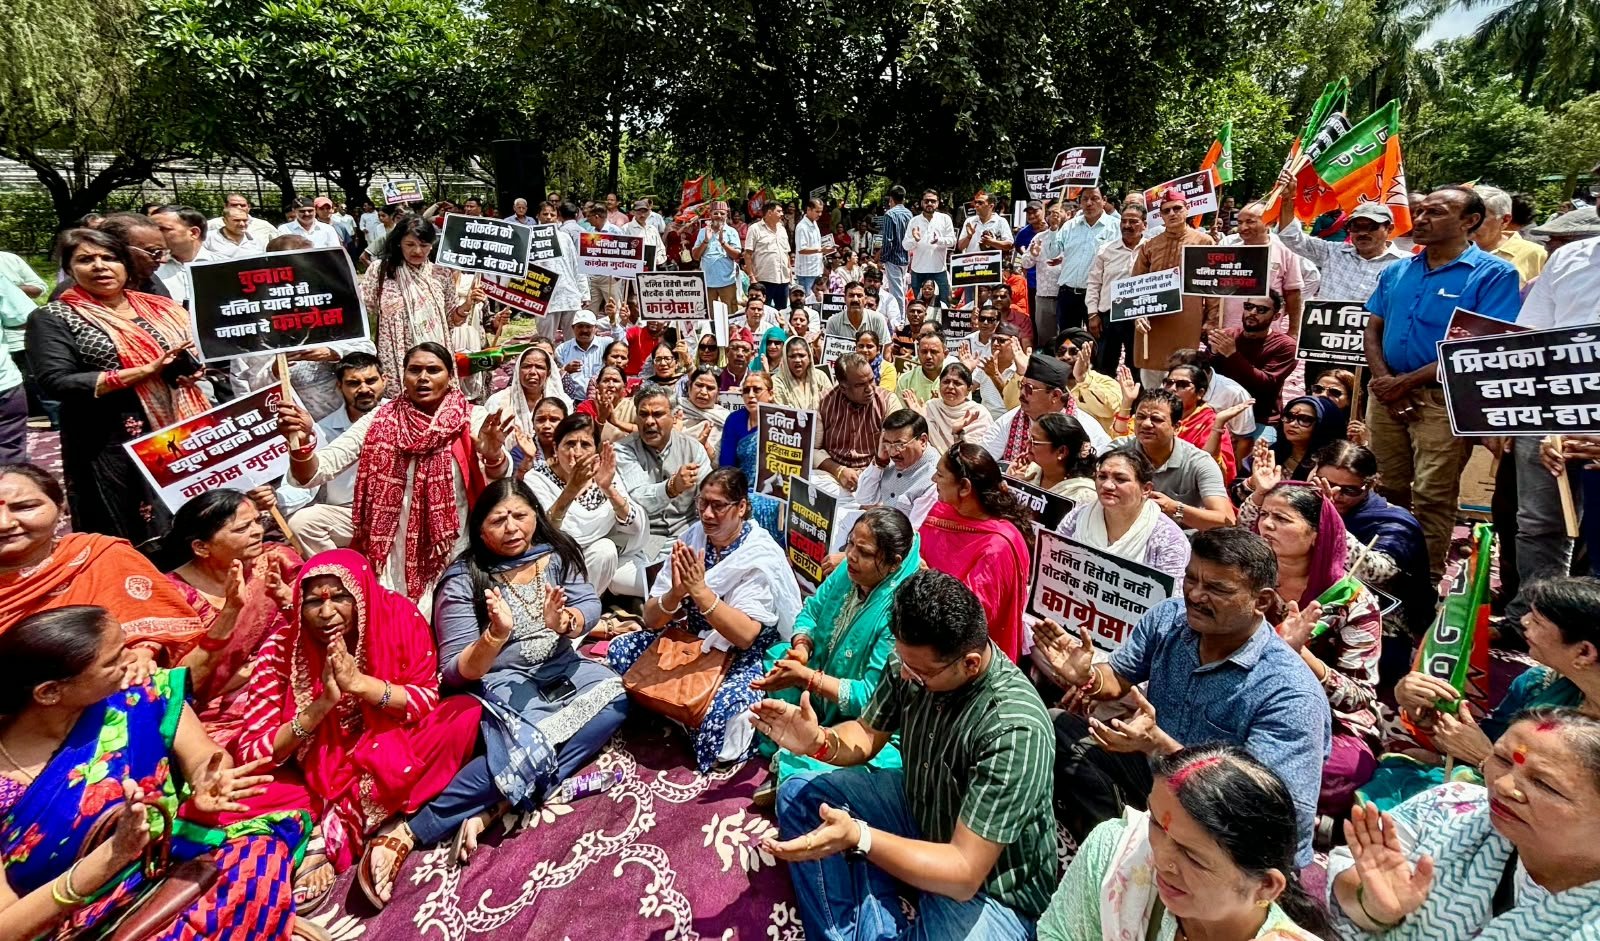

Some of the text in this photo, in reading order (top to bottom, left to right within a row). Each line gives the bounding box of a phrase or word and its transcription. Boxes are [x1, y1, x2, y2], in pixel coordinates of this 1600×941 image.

[466, 220, 514, 239] लोकतंत्र को
[536, 226, 554, 238] पार्टी
[460, 236, 514, 255] बंधक बनाना
[618, 241, 628, 249] का
[442, 249, 458, 263] बंद
[458, 252, 477, 265] करो
[483, 255, 499, 269] बंद
[499, 259, 518, 273] करो
[584, 259, 608, 268] कांग्रेस
[1207, 253, 1236, 265] चुनाव
[237, 266, 295, 294] चुनाव
[1195, 267, 1215, 275] दलित
[268, 281, 309, 297] आते ही
[645, 280, 662, 288] दलित
[1212, 278, 1218, 287] दे
[1219, 277, 1257, 288] कांग्रेस
[219, 293, 333, 316] दलित याद आए?
[645, 299, 695, 315] कांग्रेस!
[1132, 295, 1158, 306] दलित
[214, 307, 344, 339] जवाब दे कांग्रेस
[1307, 309, 1332, 325] AI
[1449, 347, 1546, 374] प्रियंका
[182, 409, 263, 450] दलितों का
[766, 412, 794, 430] दलित
[768, 427, 802, 448] विरोधी
[167, 450, 208, 474] खून
[206, 429, 253, 456] बहाने
[767, 443, 802, 459] इतिहास का
[765, 454, 801, 476] हिसाब
[180, 464, 243, 498] कांग्रेस
[1031, 494, 1048, 514] को
[791, 501, 829, 530] बाबासाहेब
[791, 512, 827, 543] के सपनों की
[793, 551, 818, 577] कांग्रेस
[1050, 549, 1154, 599] दलित हितैषी नहीं
[1042, 563, 1080, 589] वोटबैंक
[1083, 580, 1099, 598] की
